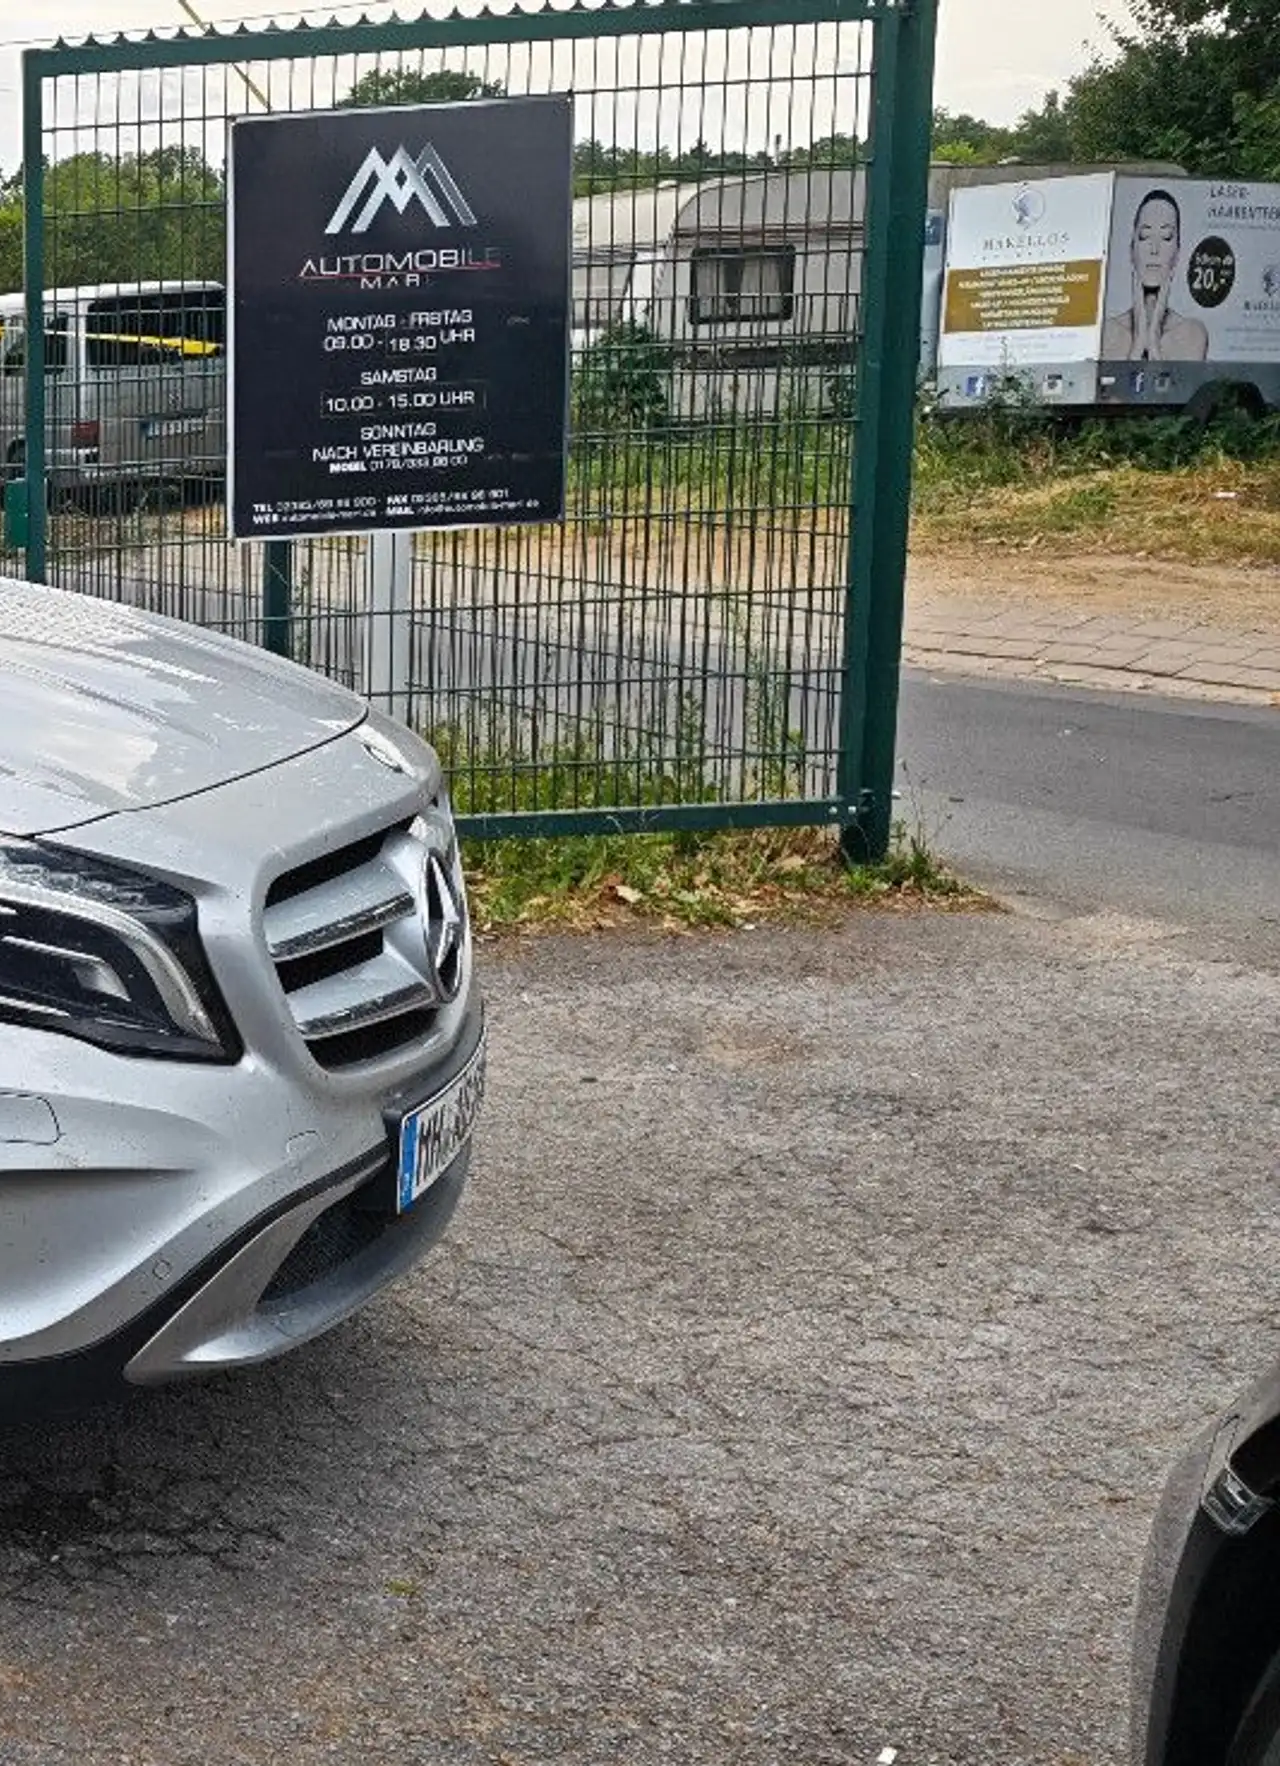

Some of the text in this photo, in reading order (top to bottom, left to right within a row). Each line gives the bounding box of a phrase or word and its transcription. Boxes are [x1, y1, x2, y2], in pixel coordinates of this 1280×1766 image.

[299, 247, 501, 277] AUTOMOBILE
[326, 314, 396, 333] MONTAG
[440, 328, 475, 344] UHR
[360, 367, 437, 386] SAMSTAG
[326, 395, 374, 412] 10.00
[389, 393, 436, 409] 15.00
[440, 391, 475, 405] UHR
[360, 422, 436, 441] SONNTAG
[312, 436, 485, 462] NACH VEREINBARUNG
